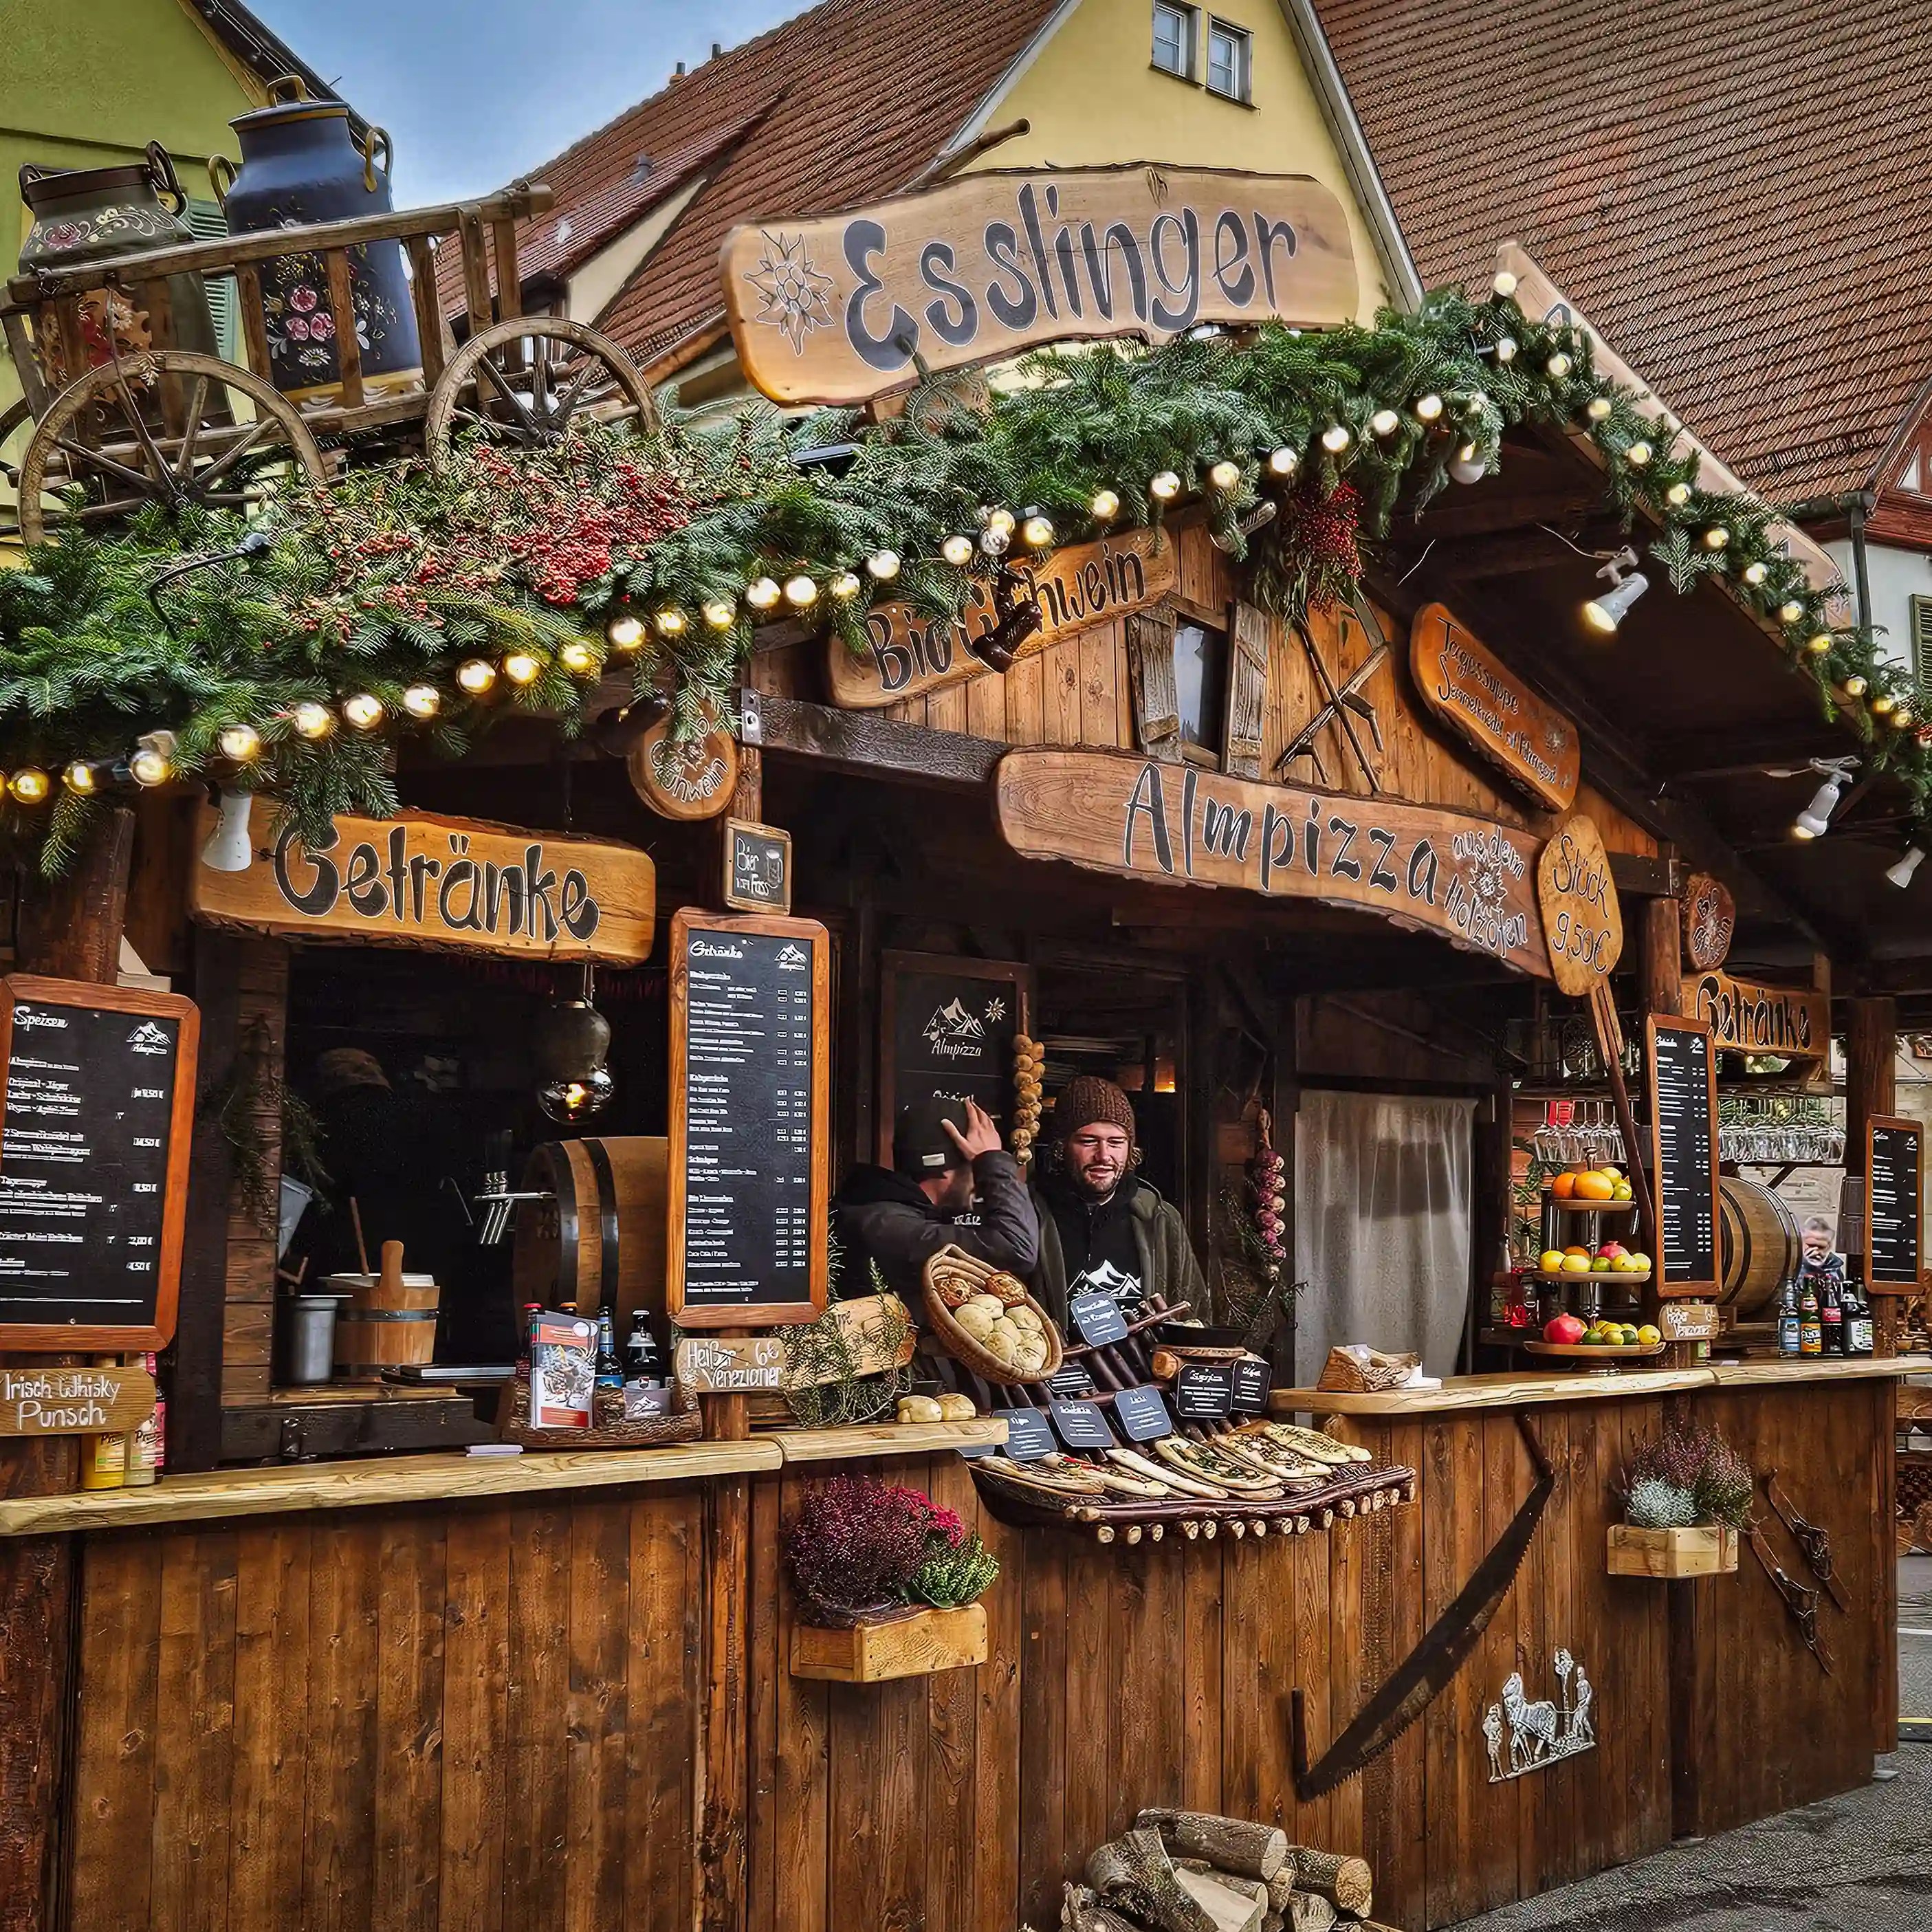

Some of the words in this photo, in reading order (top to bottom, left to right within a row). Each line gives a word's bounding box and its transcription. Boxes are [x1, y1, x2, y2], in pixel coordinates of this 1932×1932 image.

[843, 182, 1297, 373] Esslinger
[864, 612, 954, 692] Bio
[737, 837, 760, 871] Bier
[1123, 760, 1438, 908] Almpizza
[1452, 830, 1485, 860] aus
[1489, 826, 1525, 881] dem
[275, 823, 601, 943] Getränke
[1553, 833, 1610, 918] Stück
[1443, 873, 1528, 958] Holzofen
[13, 1006, 69, 1032] Speisen
[931, 1038, 982, 1060] Almpizza
[5, 1373, 52, 1400] Irisch
[701, 1366, 784, 1389] Venezianer
[19, 1400, 107, 1430] Punsch
